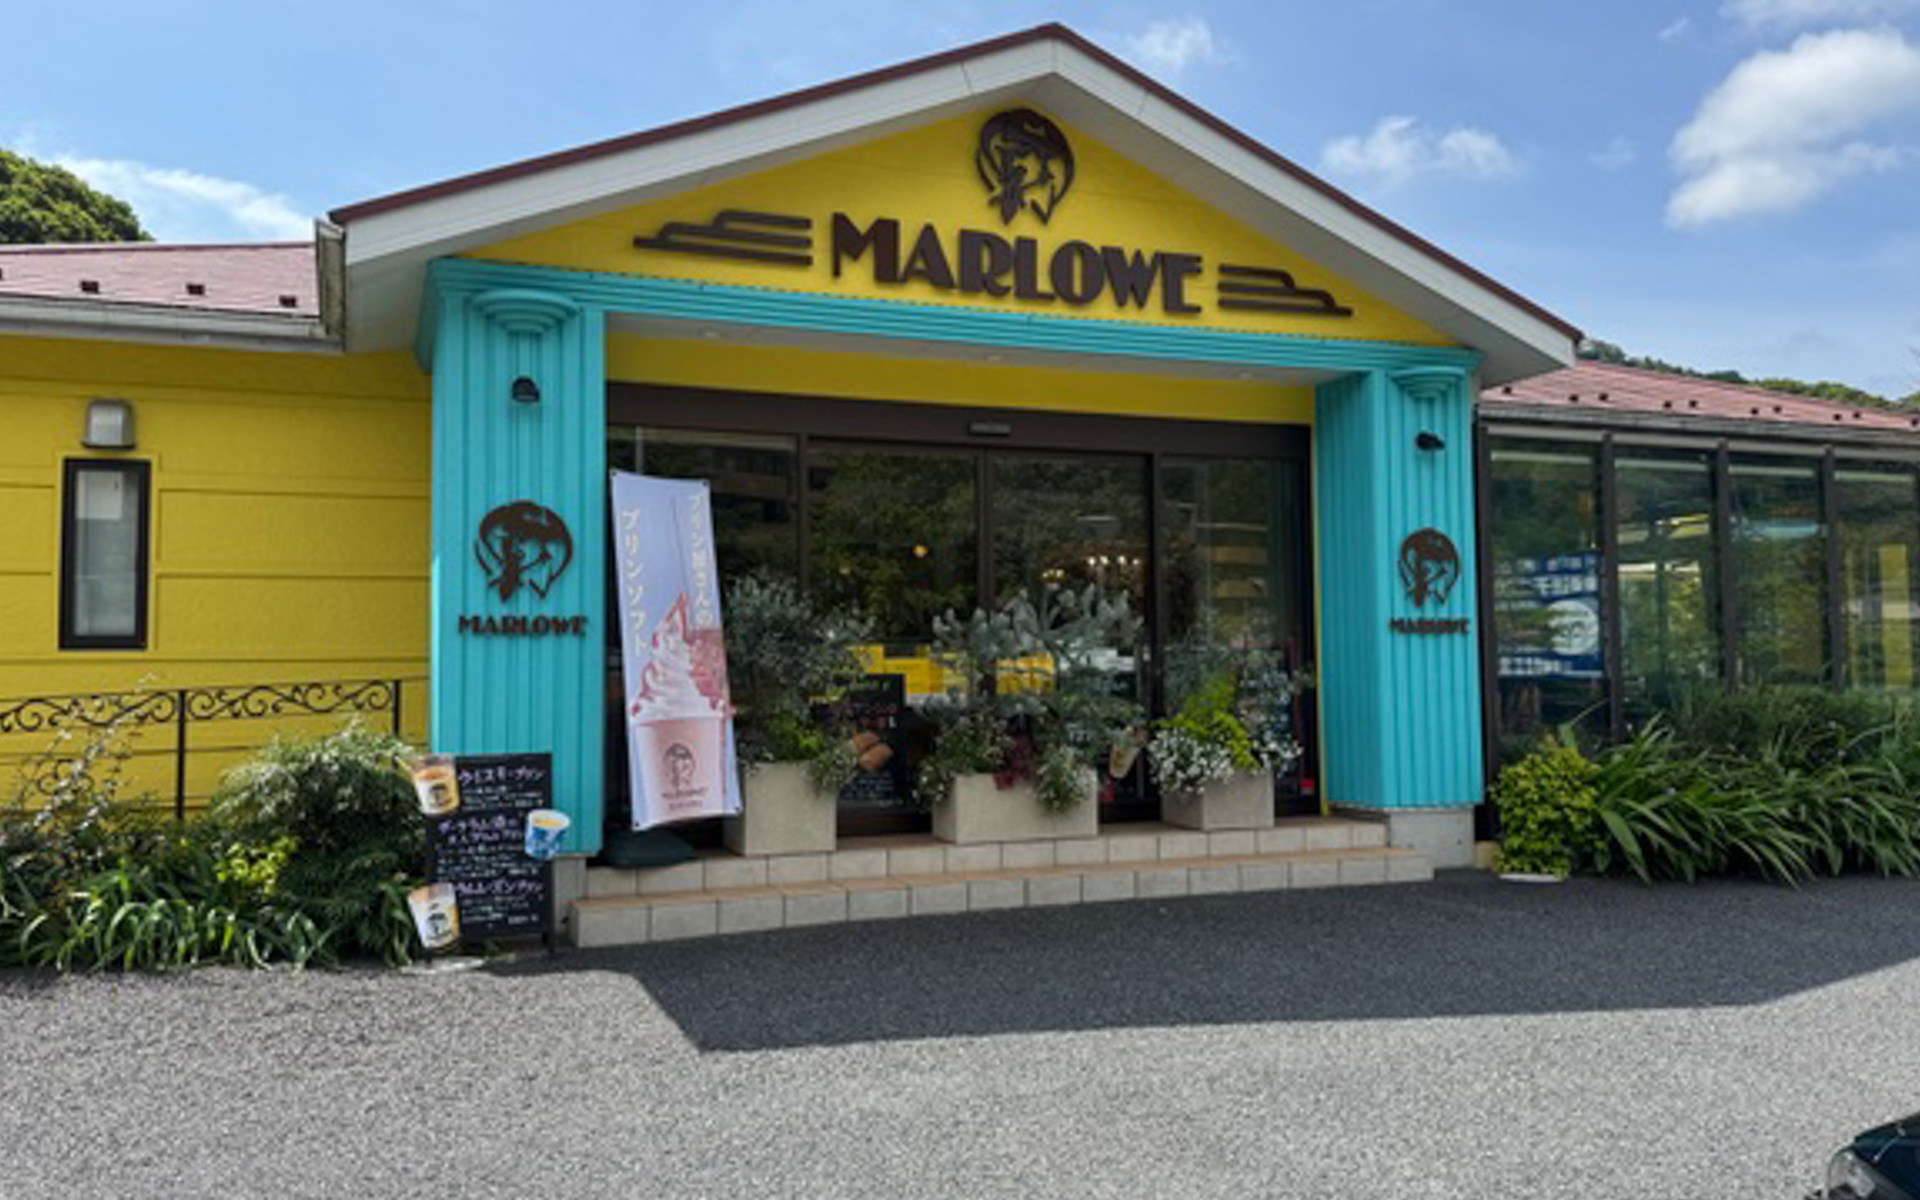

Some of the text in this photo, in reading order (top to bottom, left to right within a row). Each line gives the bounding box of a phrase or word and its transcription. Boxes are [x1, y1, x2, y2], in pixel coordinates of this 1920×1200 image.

[830, 211, 1203, 315] MARLOWE
[622, 507, 647, 657] プリンソフト
[458, 613, 588, 638] MARLOWE
[1387, 616, 1469, 635] MARLOWE
